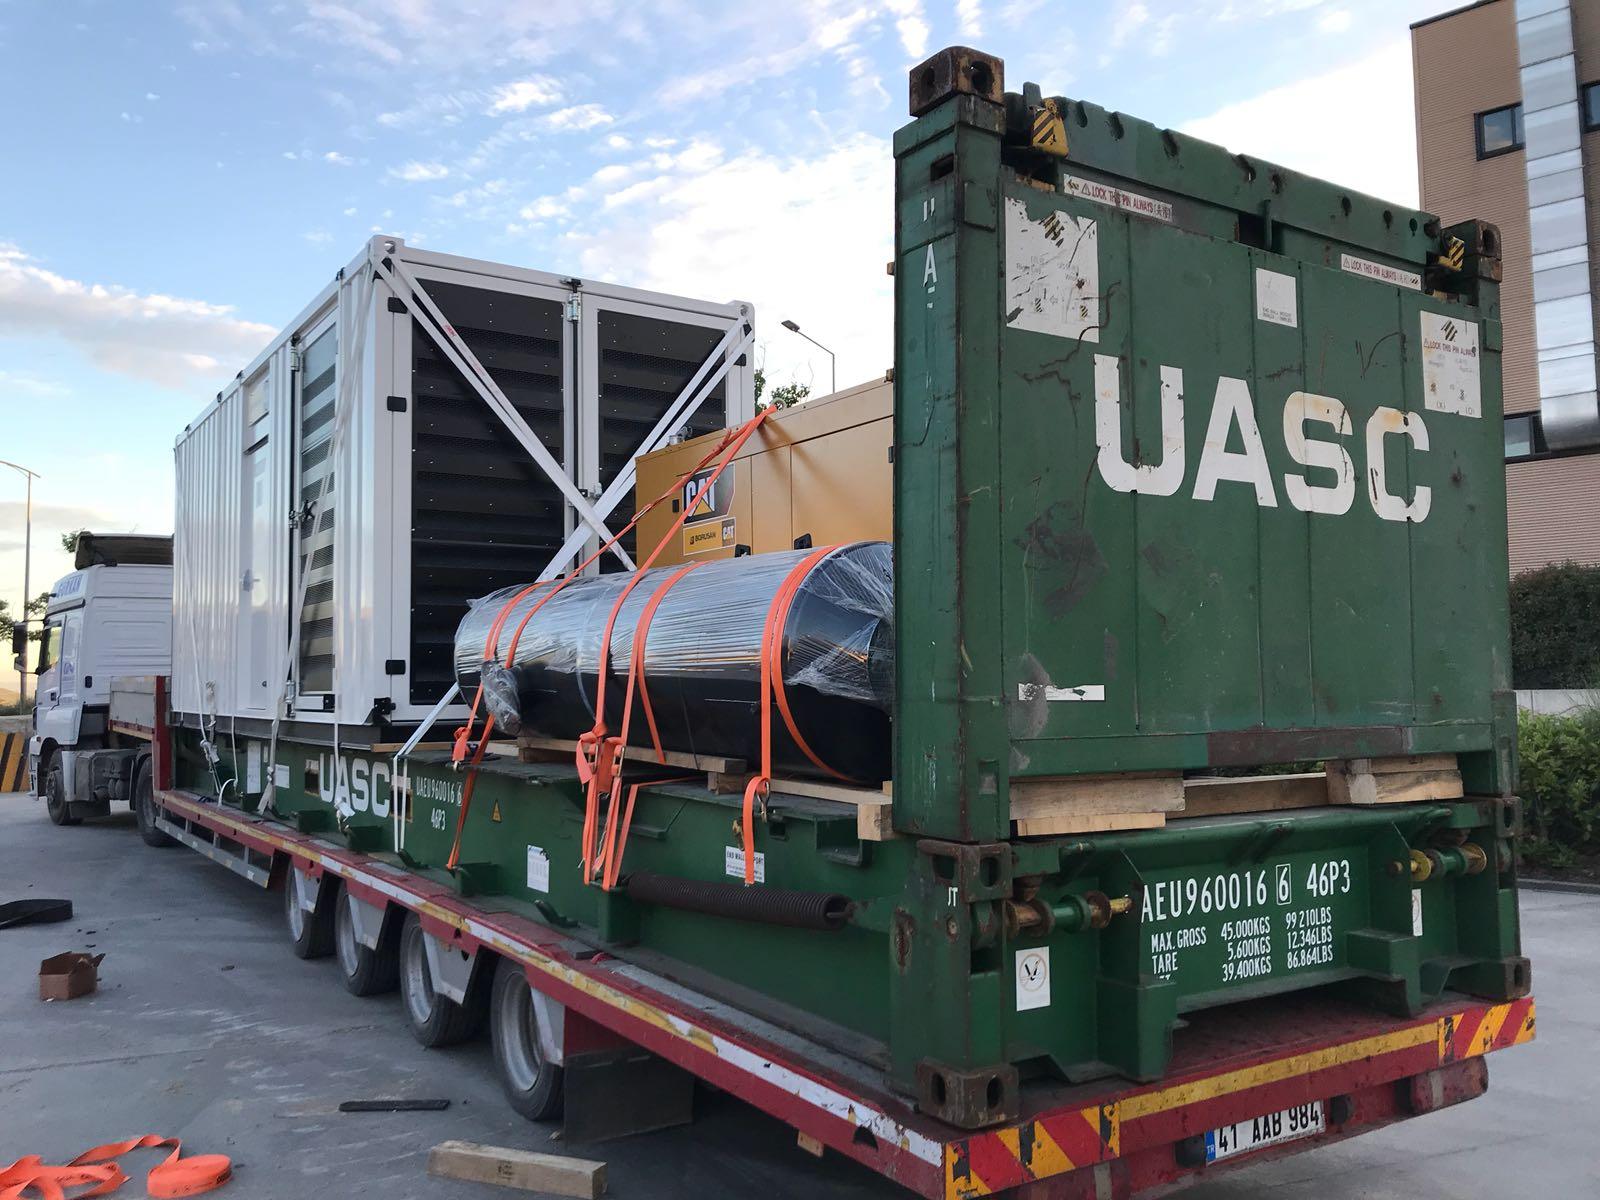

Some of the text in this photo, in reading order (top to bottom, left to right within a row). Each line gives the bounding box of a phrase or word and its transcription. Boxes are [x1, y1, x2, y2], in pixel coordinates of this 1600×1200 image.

[1091, 185, 1107, 201] LOCK
[1122, 194, 1131, 208] PIN
[1133, 198, 1154, 213] ALWAYS
[1094, 353, 1432, 524] UASC
[686, 476, 717, 517] CAT
[320, 752, 390, 818] UASC
[431, 808, 446, 831] 46P3
[1141, 859, 1350, 923] AEU960016 6 46P3
[1177, 926, 1207, 949] GROSS
[1151, 951, 1178, 974] TARE
[1206, 1102, 1319, 1153] TR 41 AAB 984
